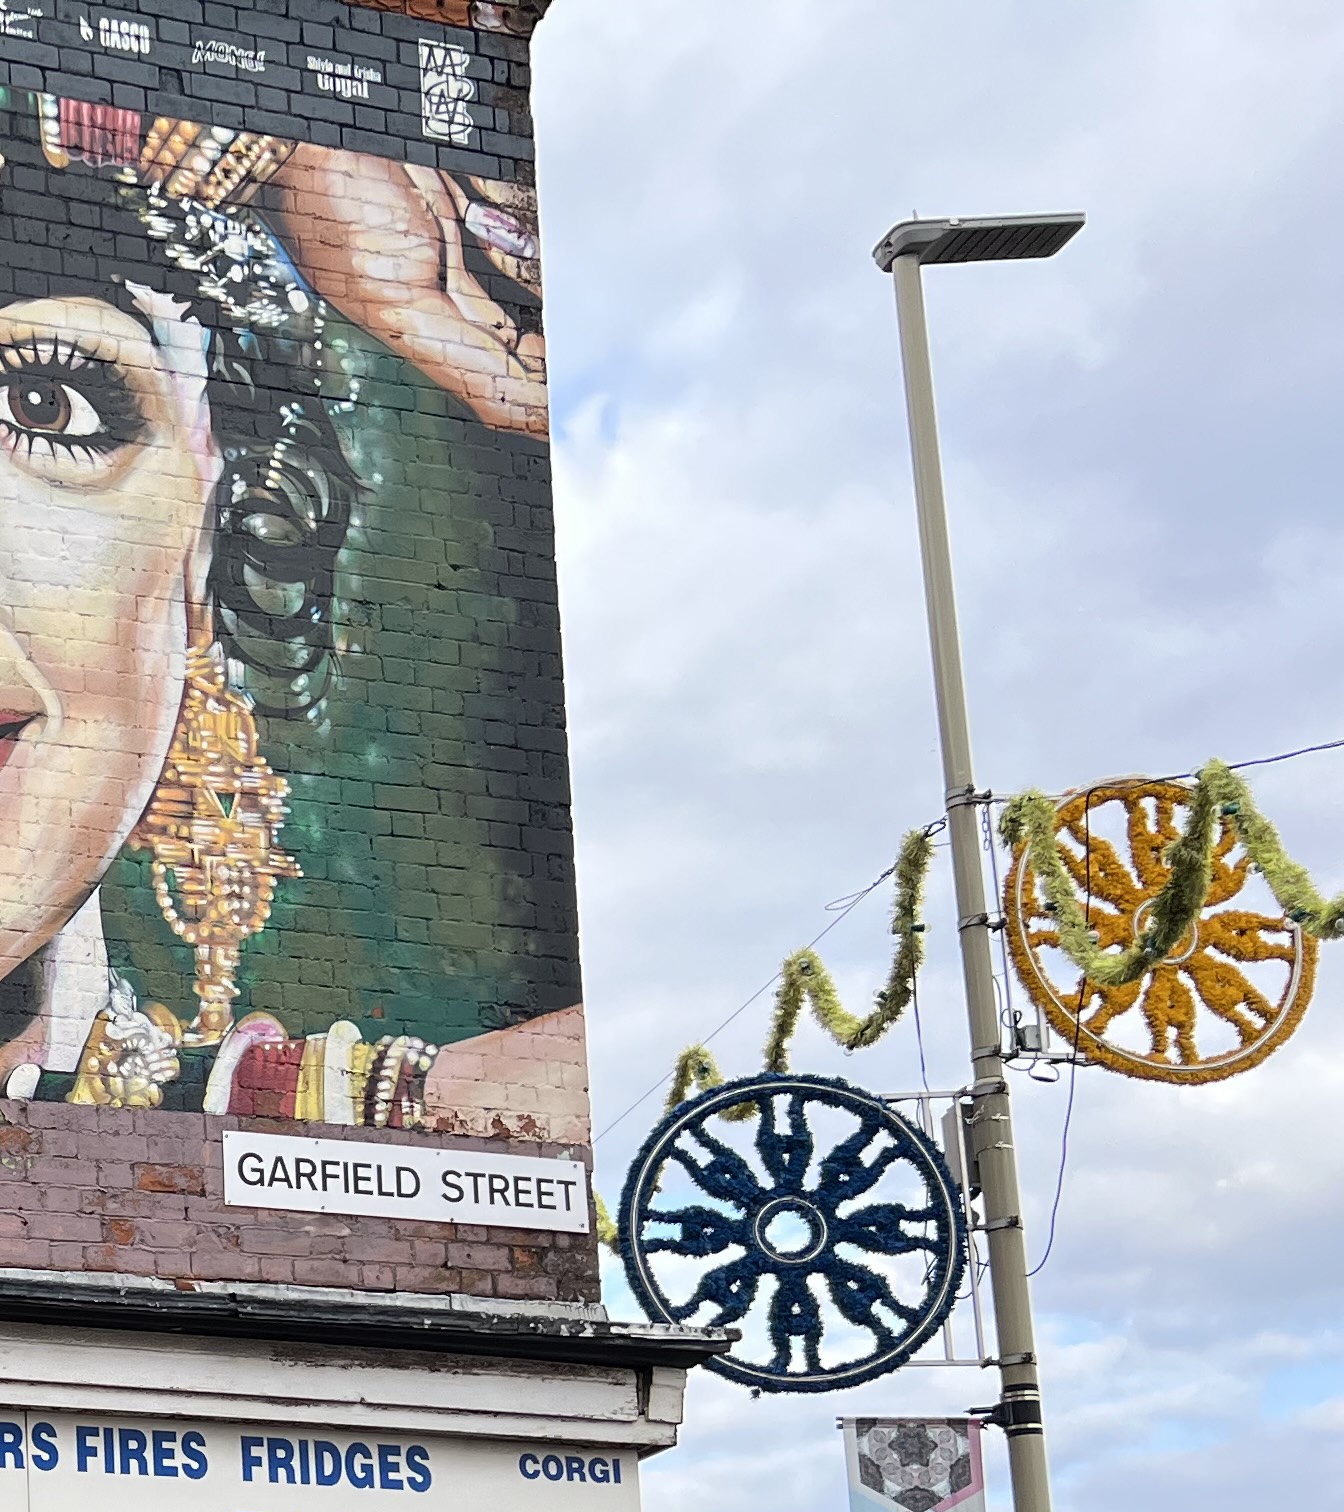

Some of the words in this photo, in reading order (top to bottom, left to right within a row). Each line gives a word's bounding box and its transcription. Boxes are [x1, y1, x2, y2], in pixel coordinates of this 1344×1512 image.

[99, 17, 150, 55] GASCO
[237, 1151, 421, 1199] GARFIELD
[440, 1169, 577, 1212] STREET
[76, 1425, 209, 1480] FIRES
[240, 1435, 432, 1493] FRIDGES
[518, 1452, 622, 1485] CORGI
